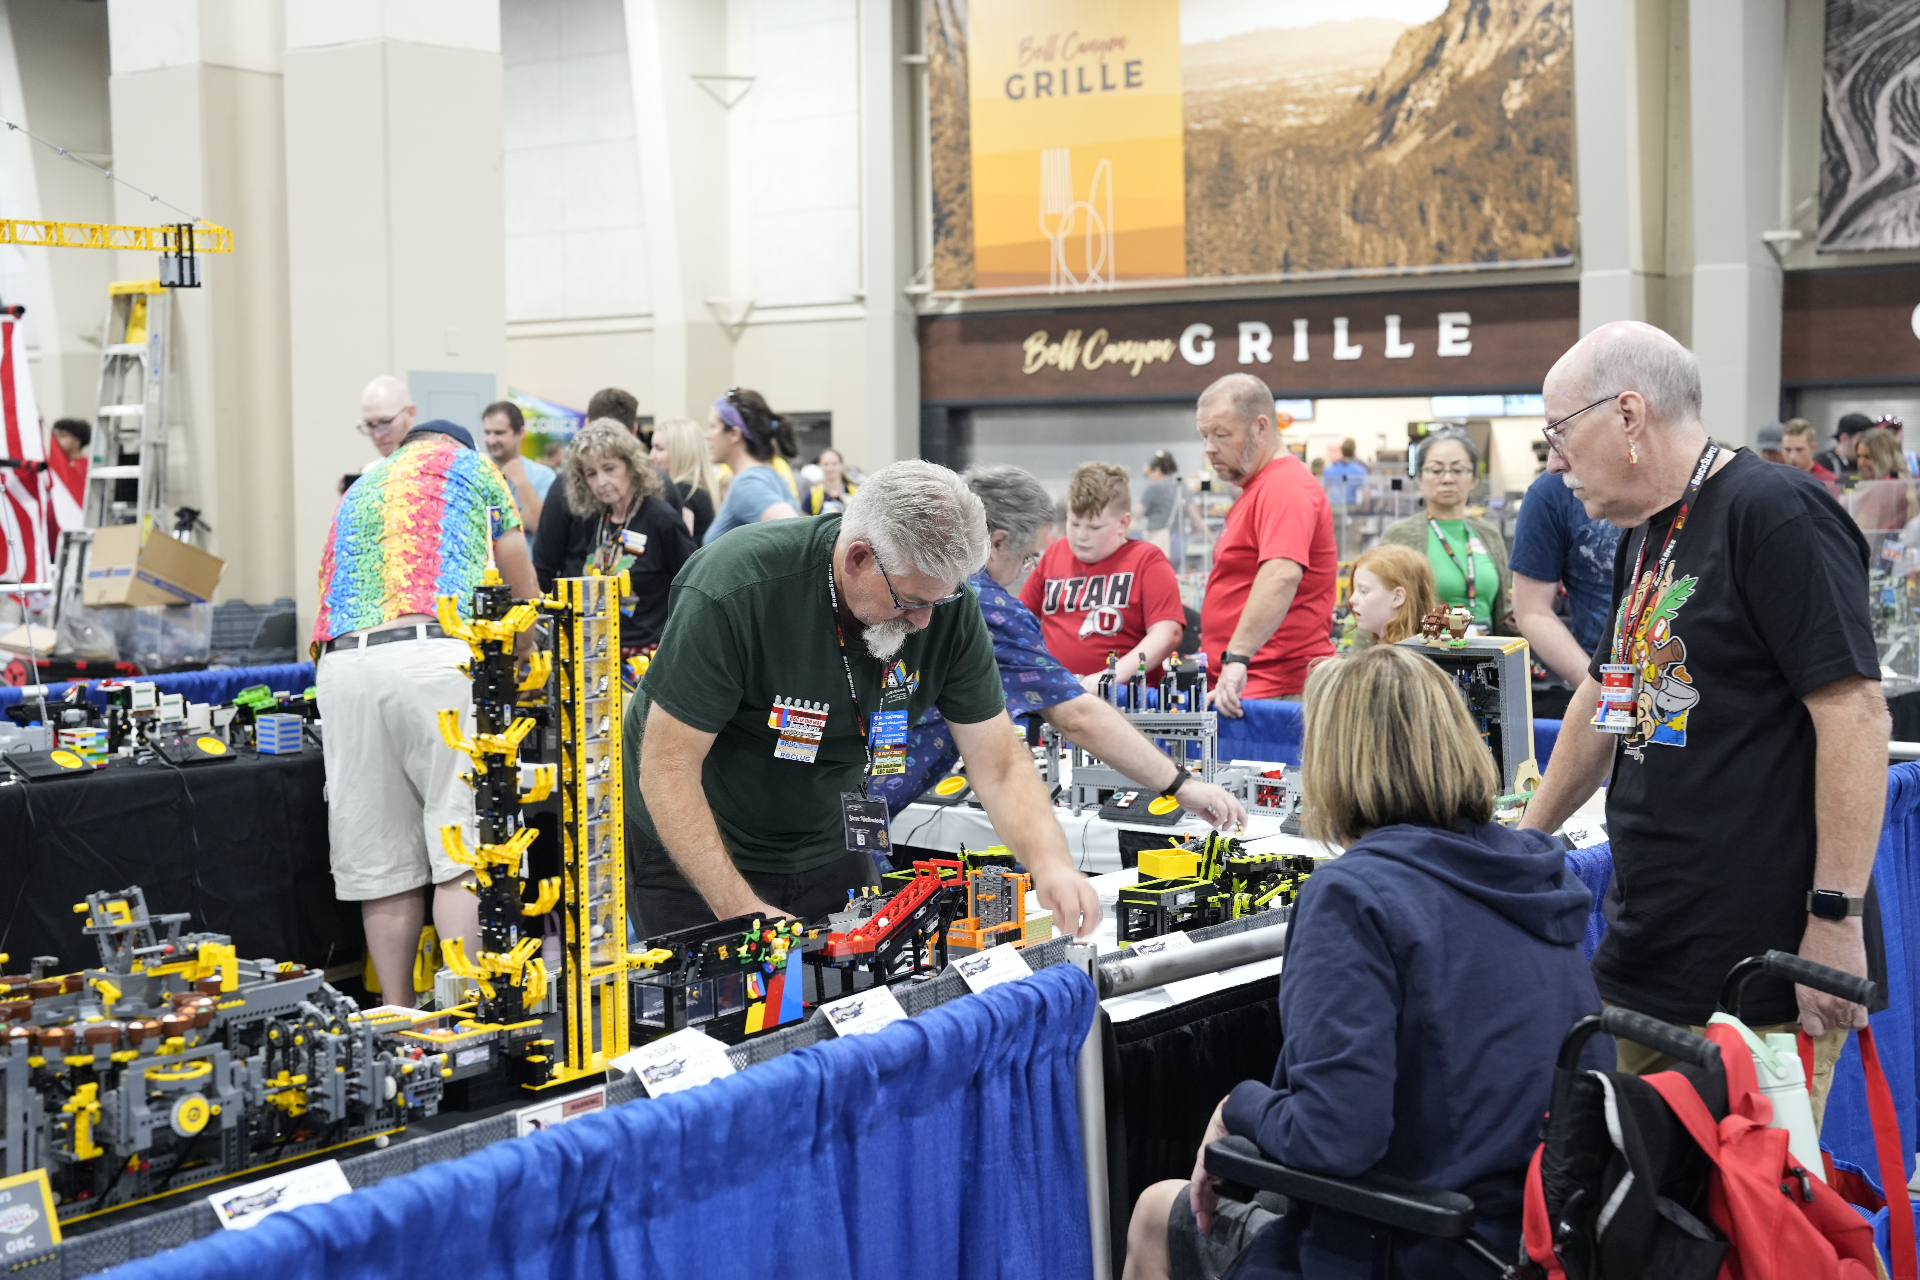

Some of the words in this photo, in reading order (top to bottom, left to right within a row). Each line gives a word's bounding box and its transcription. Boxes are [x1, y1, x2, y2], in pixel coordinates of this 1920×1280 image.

[1017, 32, 1060, 68] Bell
[1060, 30, 1127, 64] Canyon
[1005, 59, 1143, 101] GRILLE
[1022, 328, 1083, 375] Bell
[1081, 328, 1177, 377] Canyon
[1179, 311, 1473, 366] GRILLE
[1042, 572, 1134, 615] UTAH
[1098, 611, 1117, 631] U
[644, 1042, 682, 1059] PLEASE
[5, 1234, 37, 1255] GBC
